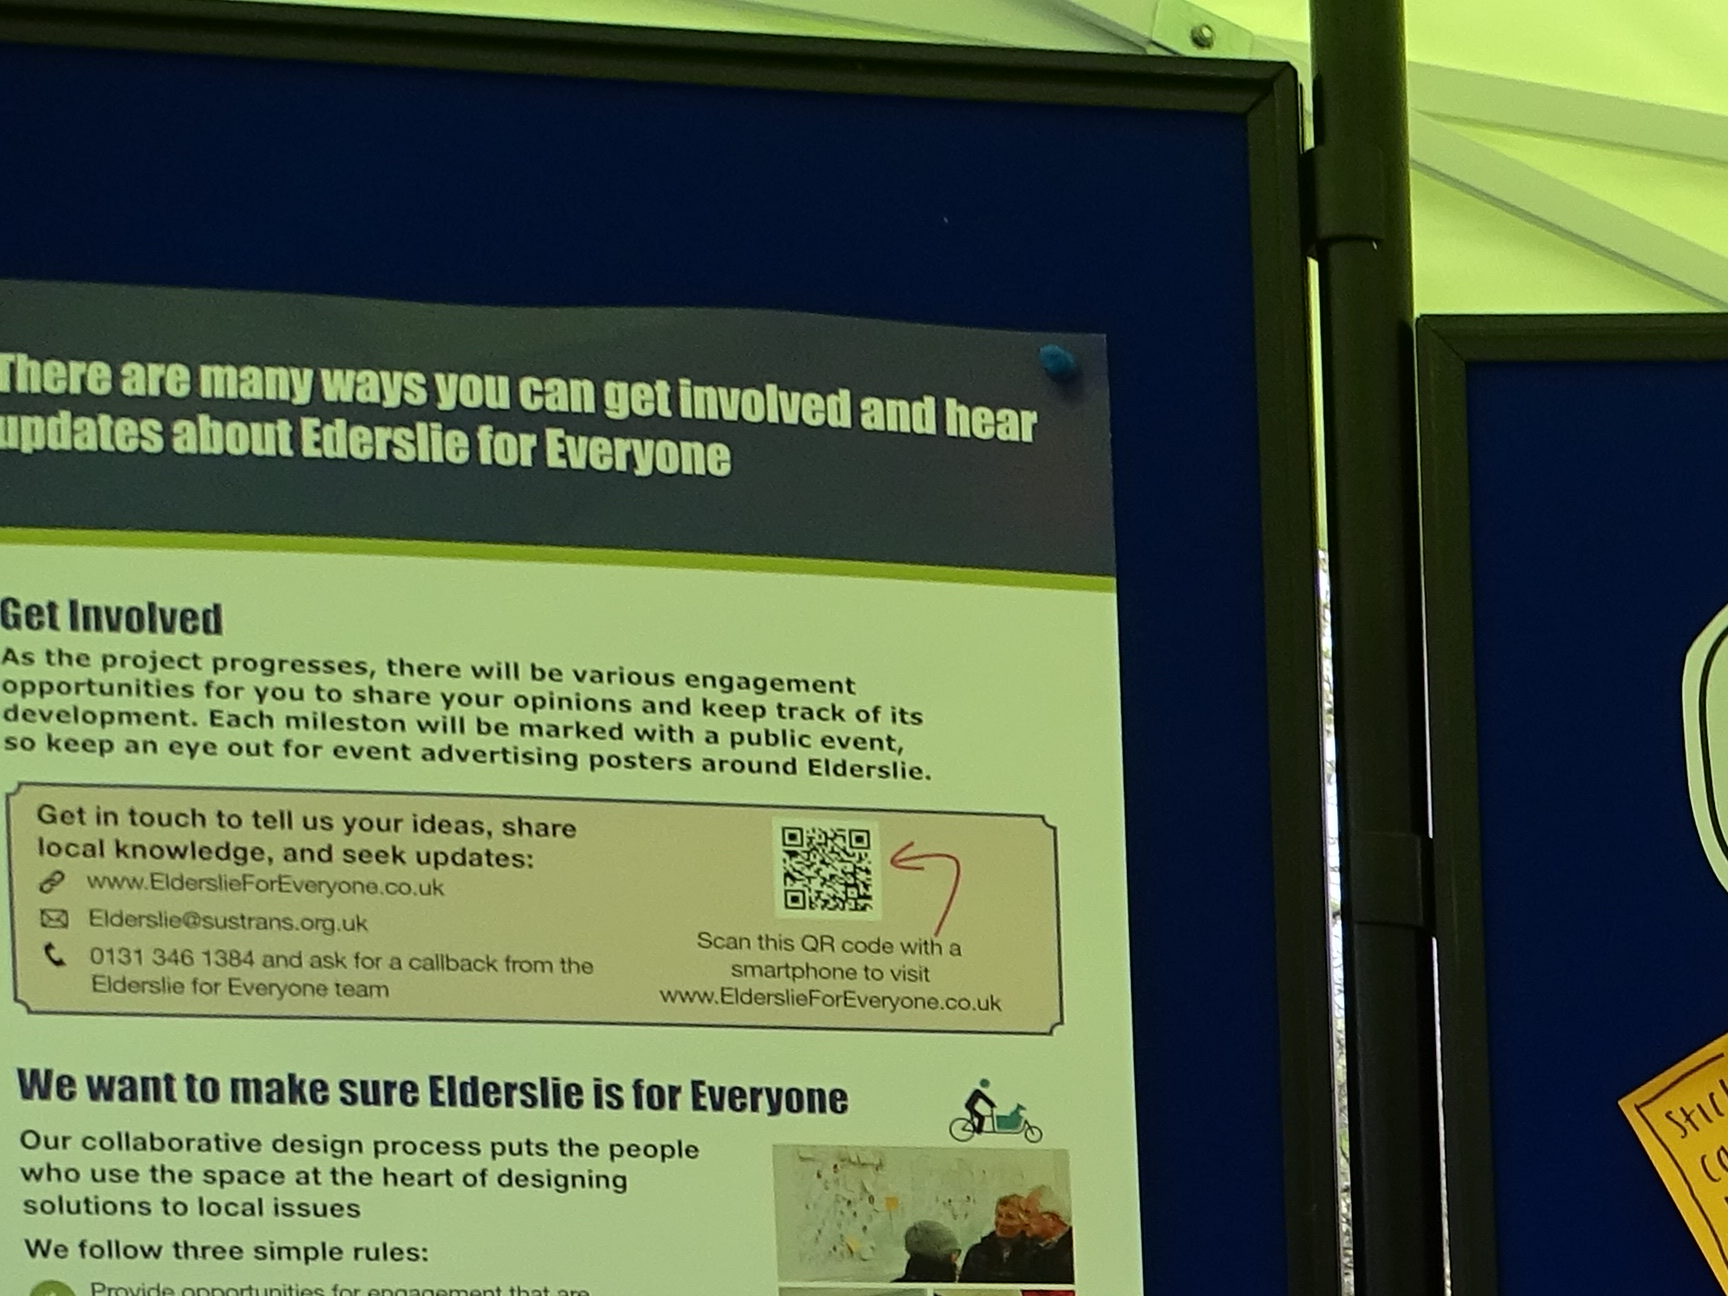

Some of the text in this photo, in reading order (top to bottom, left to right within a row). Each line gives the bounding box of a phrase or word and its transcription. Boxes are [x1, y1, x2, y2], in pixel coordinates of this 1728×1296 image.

[0, 352, 1038, 443] There are many ways you can get involved and hear
[0, 409, 731, 477] updates about Ederslie for Everyone
[0, 596, 223, 636] Get Involved
[86, 871, 445, 899] www.ElderslieForEveryone.co.uk
[88, 908, 369, 937] Elderslie@sustrans.org.uk
[16, 1067, 849, 1117] We want to make sure Elderslie is for Everyone
